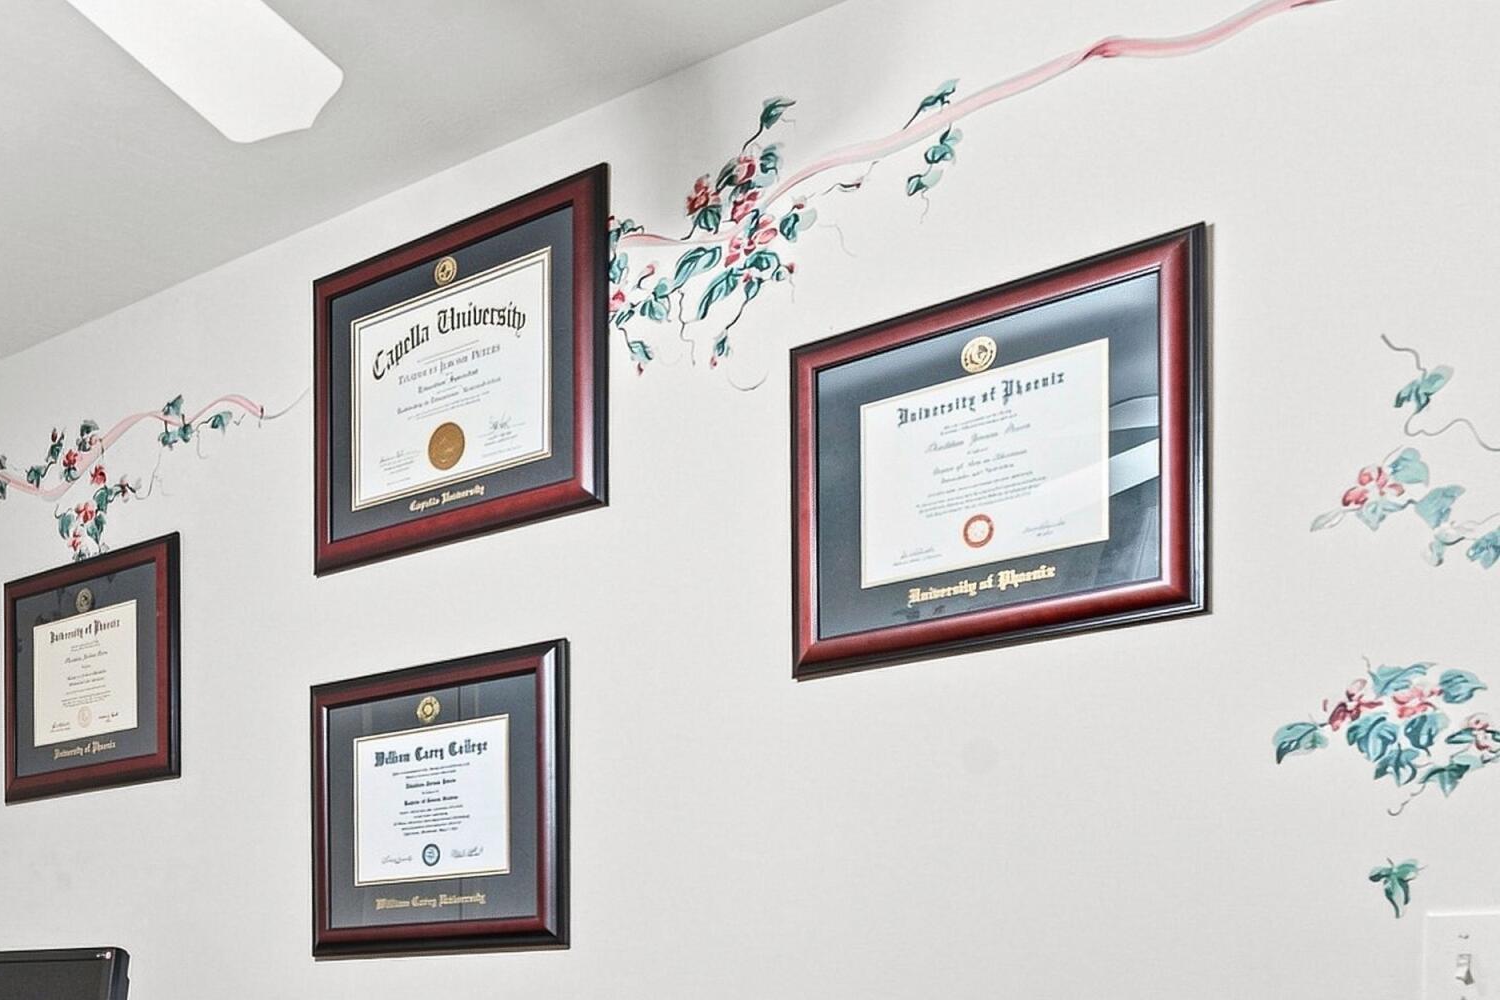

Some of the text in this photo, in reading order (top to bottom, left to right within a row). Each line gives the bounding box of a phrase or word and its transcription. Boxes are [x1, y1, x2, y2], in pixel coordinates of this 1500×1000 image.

[372, 323, 430, 380] Capella
[437, 301, 526, 338] University
[897, 394, 976, 428] University
[981, 387, 996, 403] of
[1001, 371, 1066, 405] Phoenix
[907, 564, 1056, 608] University of Phoenix
